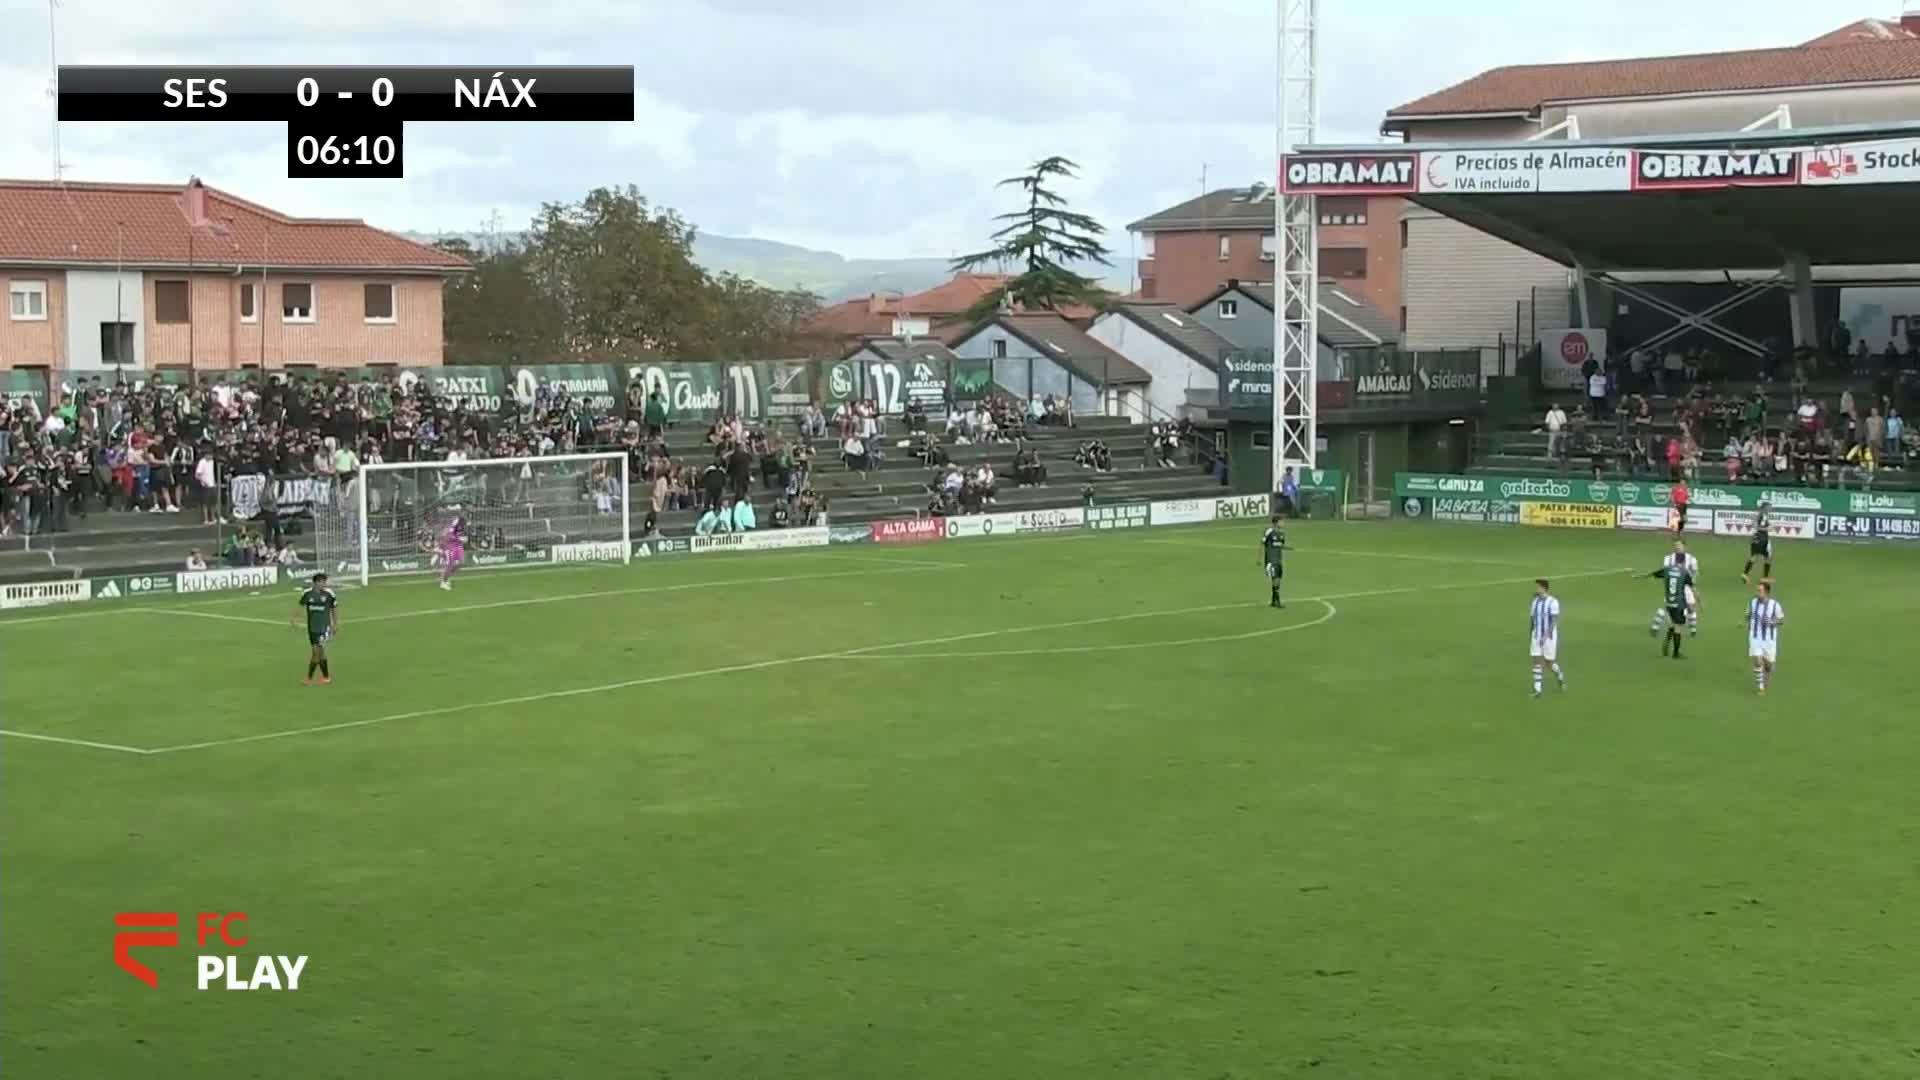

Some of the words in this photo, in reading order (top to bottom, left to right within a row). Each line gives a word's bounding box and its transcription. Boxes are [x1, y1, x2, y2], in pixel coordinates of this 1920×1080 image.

[1455, 154, 1518, 171] Precios
[1525, 153, 1544, 170] de
[1550, 152, 1627, 170] Almacén
[1640, 151, 1791, 178] OBRAMAT
[1864, 149, 1920, 170] Stock
[1288, 158, 1414, 186] OBRAMAT
[1454, 177, 1477, 190] IVA
[1478, 176, 1531, 190] incluido
[870, 363, 905, 414] 12
[1357, 375, 1412, 393] AMAIGAS
[1430, 370, 1476, 390] sidenor
[729, 365, 759, 418] 11
[1215, 499, 1239, 519] Feu
[1240, 495, 1267, 516] Vert
[1539, 503, 1566, 513] PATXI
[1569, 504, 1613, 514] PEINADO
[883, 522, 906, 535] ALTA
[907, 520, 936, 533] GAMA
[695, 533, 745, 549] miramar
[181, 568, 273, 592] kutxabank
[5, 582, 82, 601] miramar
